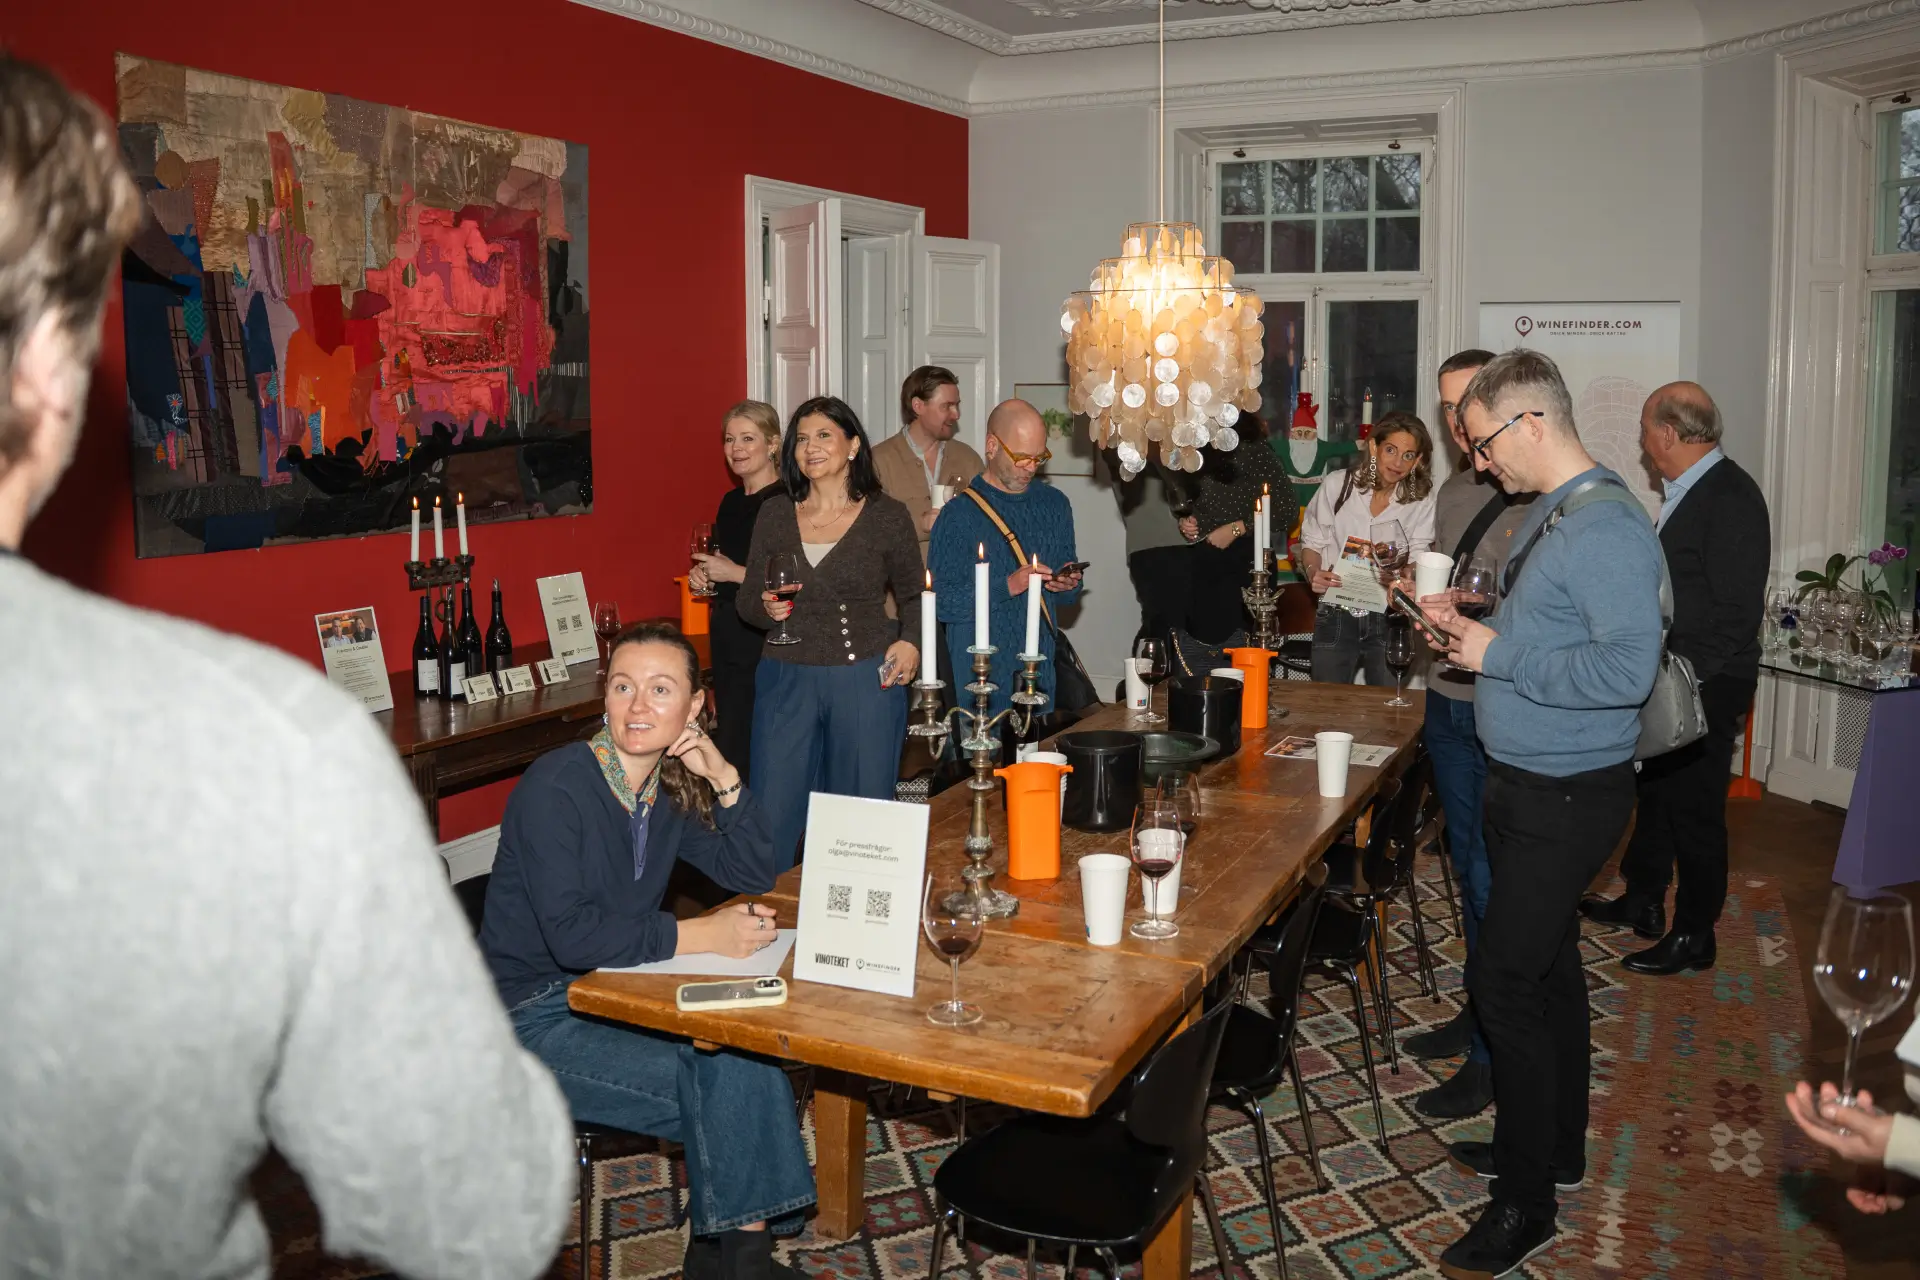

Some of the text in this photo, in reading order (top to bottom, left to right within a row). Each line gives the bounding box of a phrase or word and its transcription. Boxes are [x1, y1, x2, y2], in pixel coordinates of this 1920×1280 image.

[1537, 320, 1642, 329] WINEFINDER.COM
[836, 839, 848, 847] För
[828, 848, 899, 862] olga@vinoteket.com
[815, 953, 850, 968] VINOTEKET
